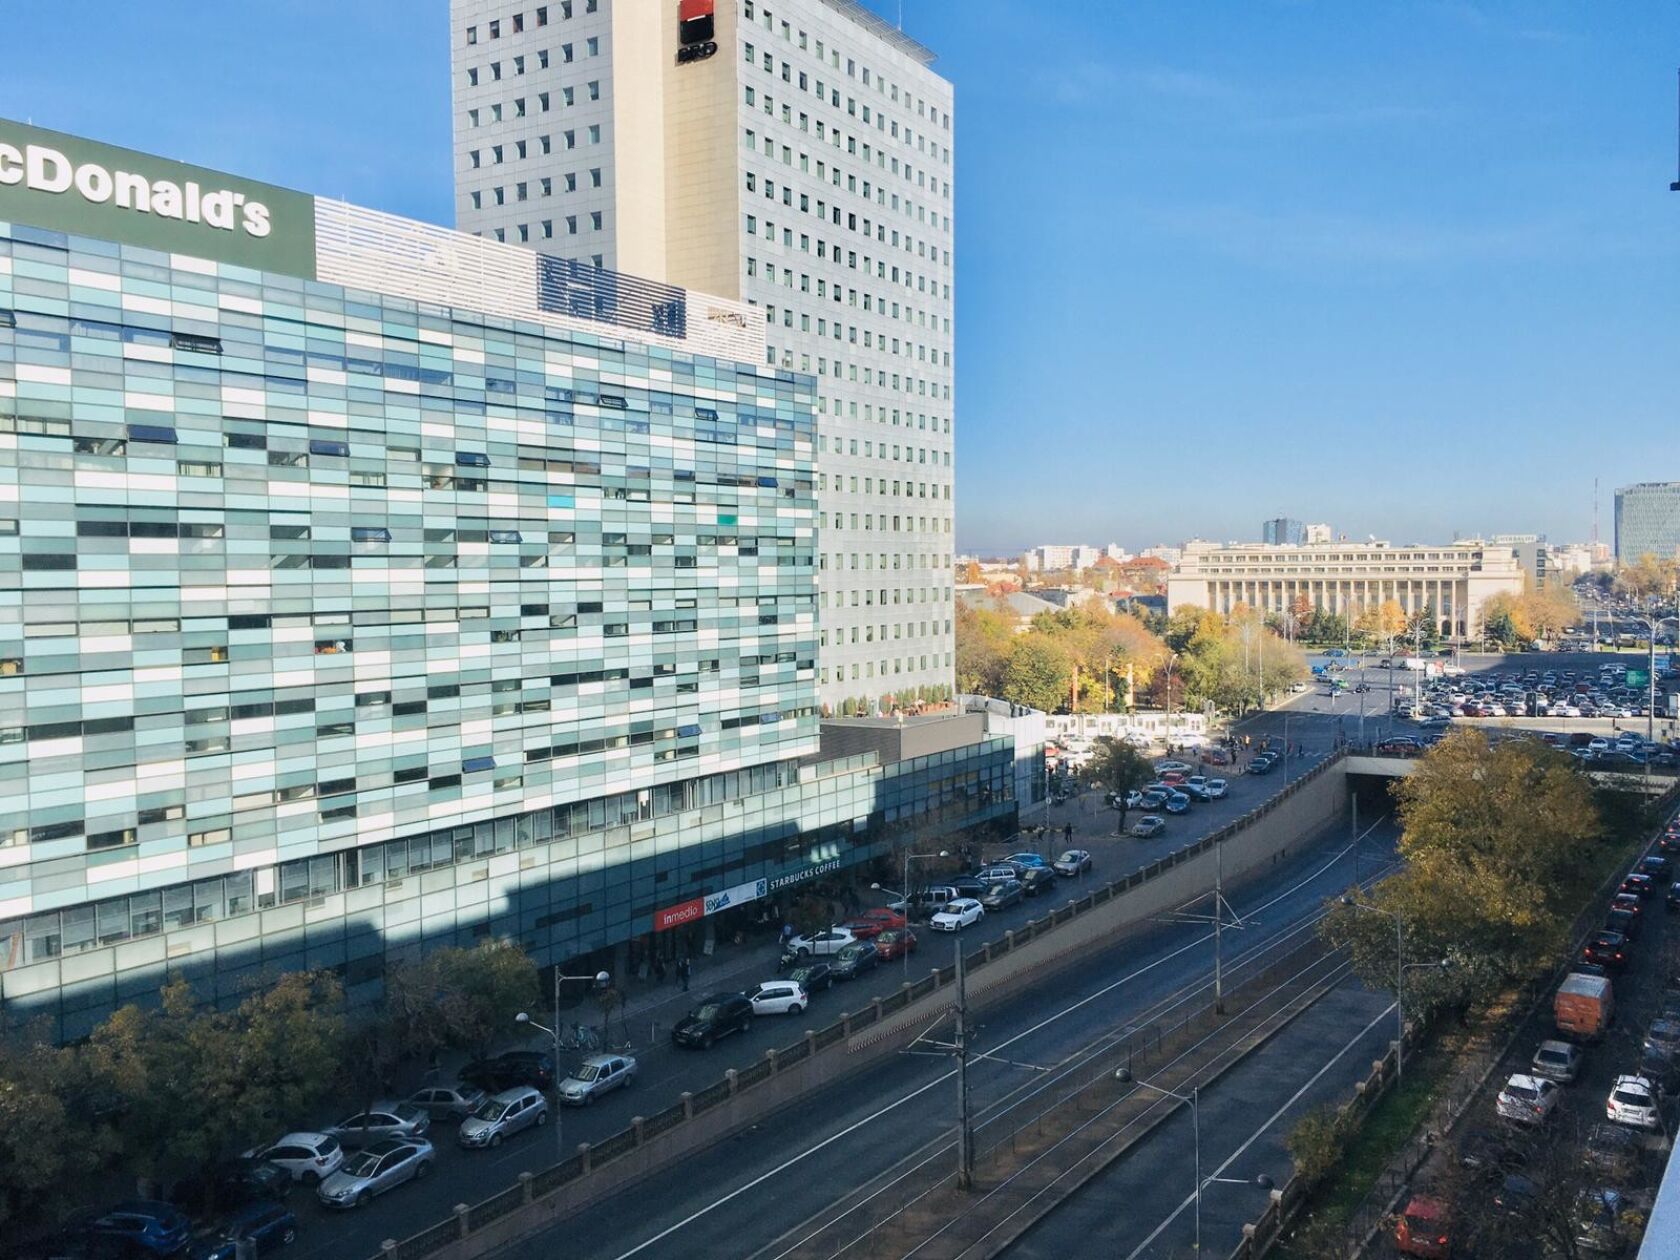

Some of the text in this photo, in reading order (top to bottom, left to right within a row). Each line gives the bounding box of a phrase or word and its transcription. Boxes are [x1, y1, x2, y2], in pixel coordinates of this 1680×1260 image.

[770, 859, 840, 890] STARBUCKS COFFEE
[663, 905, 697, 925] inmedio
